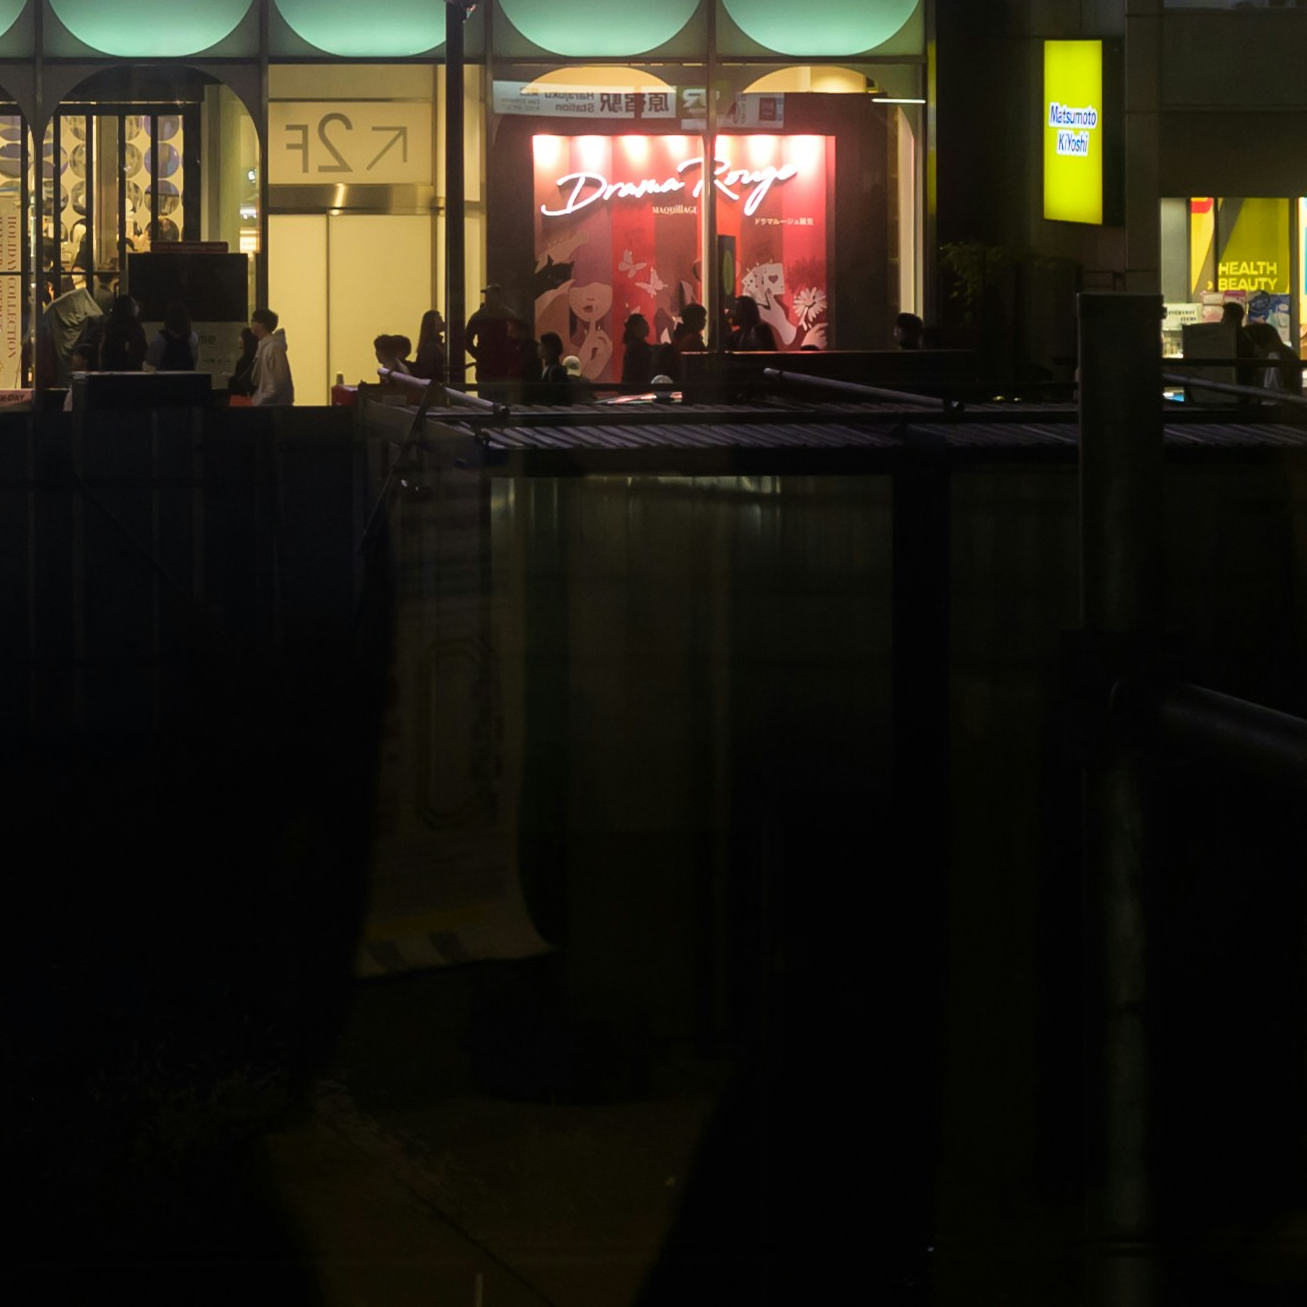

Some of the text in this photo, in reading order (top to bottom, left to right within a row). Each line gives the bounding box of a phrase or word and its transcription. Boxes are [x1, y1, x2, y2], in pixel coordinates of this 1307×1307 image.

[1050, 104, 1097, 127] Matsumoto
[540, 157, 798, 217] Drama Rouge
[1218, 261, 1278, 276] HEALTH
[7, 215, 17, 359] HOLIDAY COLLECTION
[1218, 277, 1279, 292] BEAUTY
